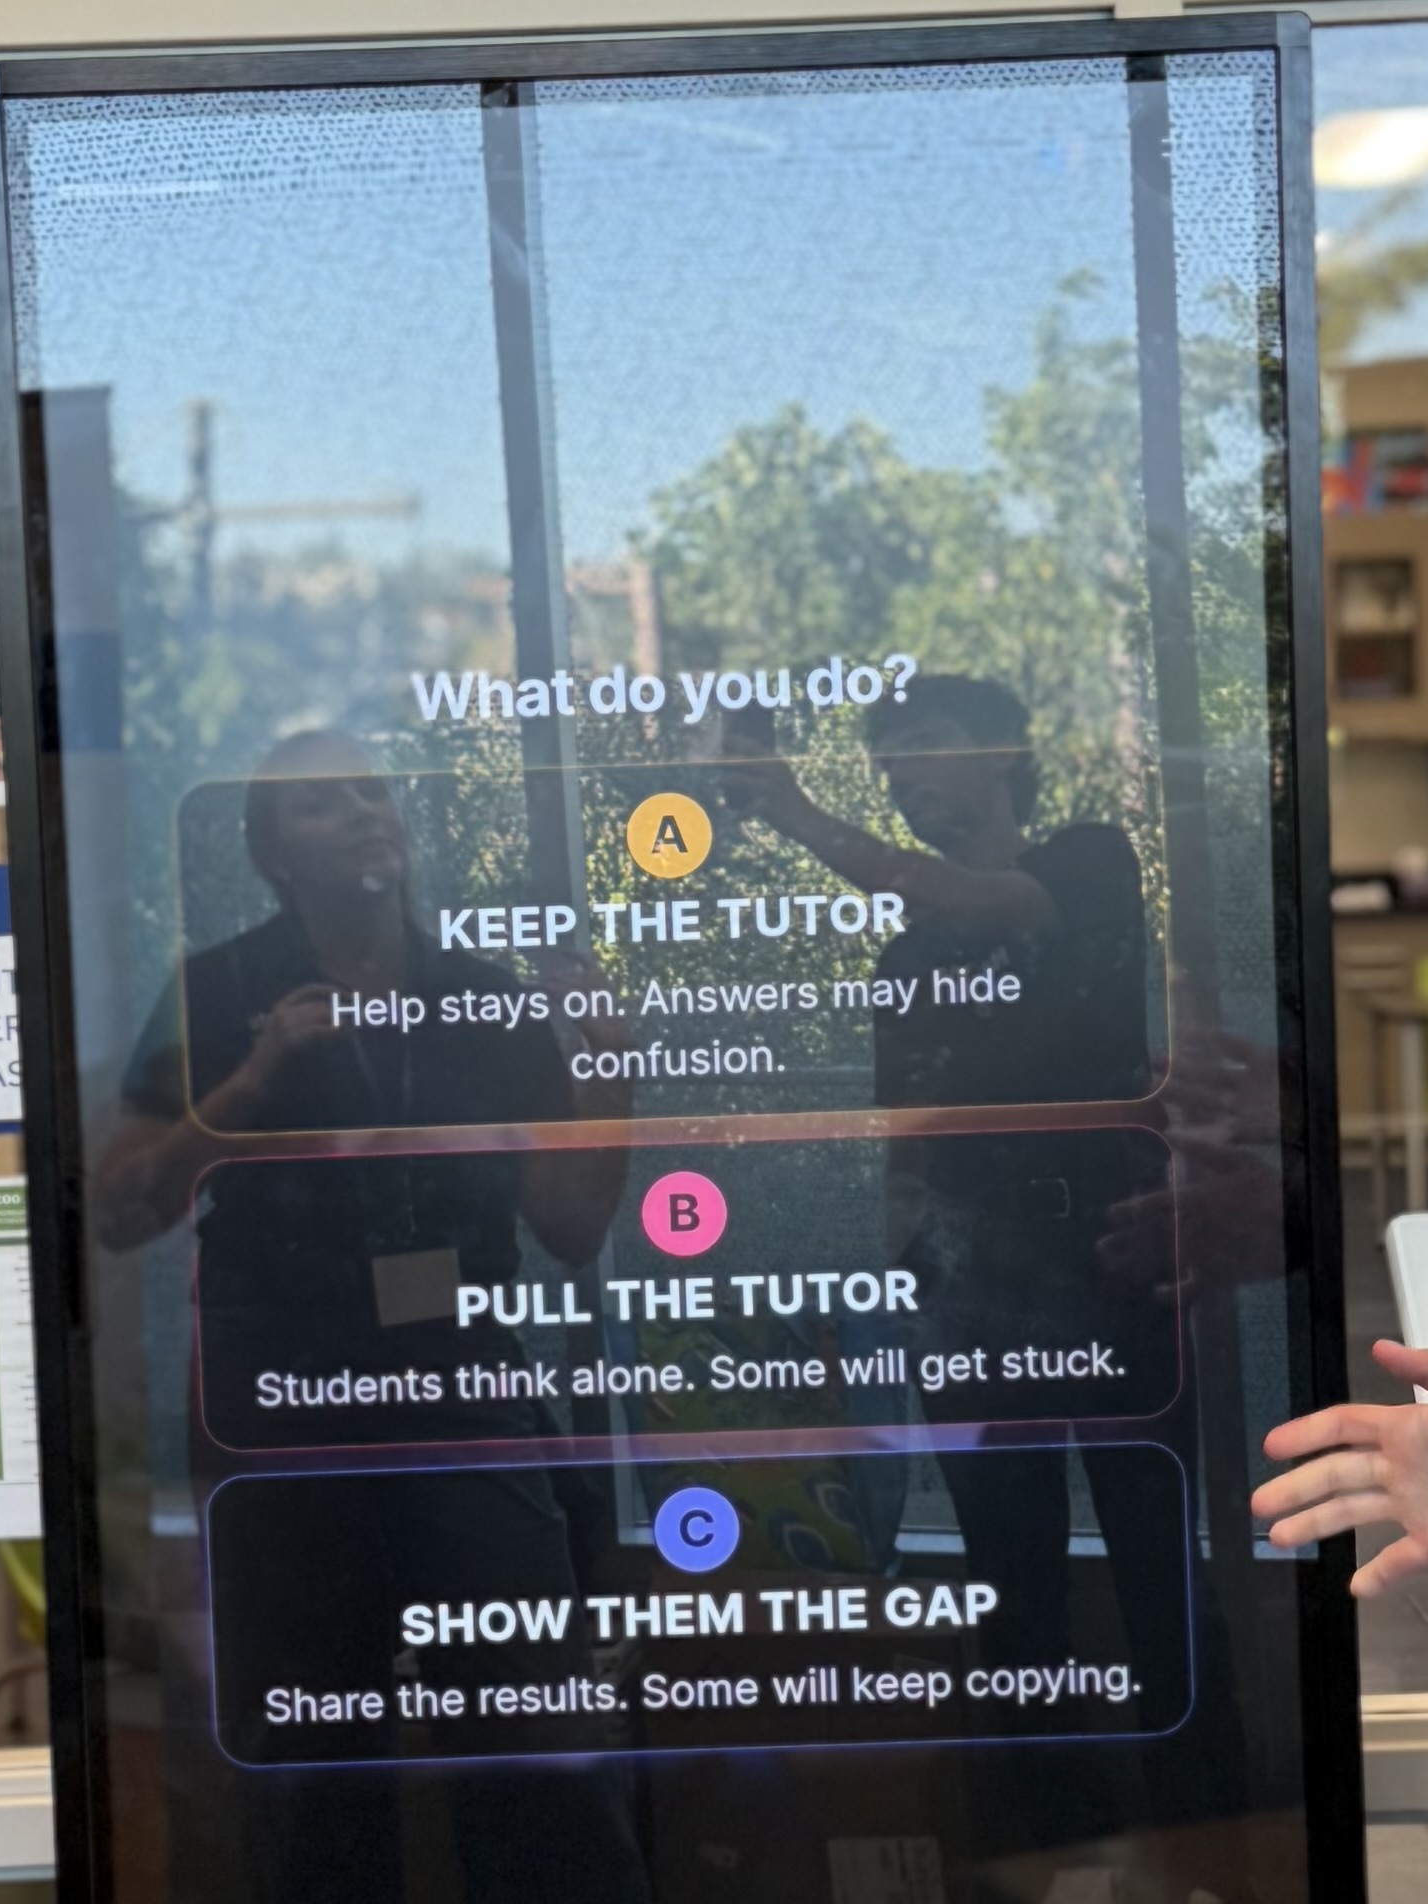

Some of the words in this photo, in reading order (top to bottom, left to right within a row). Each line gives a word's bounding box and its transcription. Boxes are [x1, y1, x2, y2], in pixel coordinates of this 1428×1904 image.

[412, 668, 576, 722] What
[589, 665, 665, 718] do
[681, 664, 793, 726] you
[805, 654, 918, 708] do?
[652, 816, 688, 856] A
[439, 905, 577, 951] KEEP
[593, 900, 702, 944] THE
[716, 892, 906, 939] TUTOR
[331, 990, 426, 1034] Help
[440, 989, 550, 1030] stays
[562, 981, 627, 1020] on.
[640, 976, 818, 1018] Answers
[832, 973, 917, 1016] may
[932, 967, 1022, 1006] hide
[571, 1038, 786, 1083] confusion.
[668, 1195, 700, 1232] B
[456, 1282, 593, 1329] PULL
[605, 1277, 715, 1322] THE
[729, 1269, 919, 1317] TUTOR
[256, 1368, 444, 1408] Students
[454, 1361, 559, 1401] think
[571, 1359, 695, 1396] alone.
[710, 1354, 827, 1391] Some
[839, 1348, 906, 1386] will
[920, 1347, 988, 1392] get
[1001, 1341, 1126, 1380] stuck.
[679, 1509, 715, 1549] C
[401, 1597, 573, 1646] SHOW
[585, 1591, 745, 1640] THEM
[758, 1587, 869, 1633] THE
[884, 1583, 999, 1628] GAP
[265, 1687, 385, 1724] Share
[396, 1682, 466, 1719] the
[478, 1676, 628, 1716] results.
[642, 1673, 760, 1710] Some
[771, 1666, 838, 1705] will
[852, 1666, 953, 1709] keep
[965, 1657, 1142, 1705] copying.
